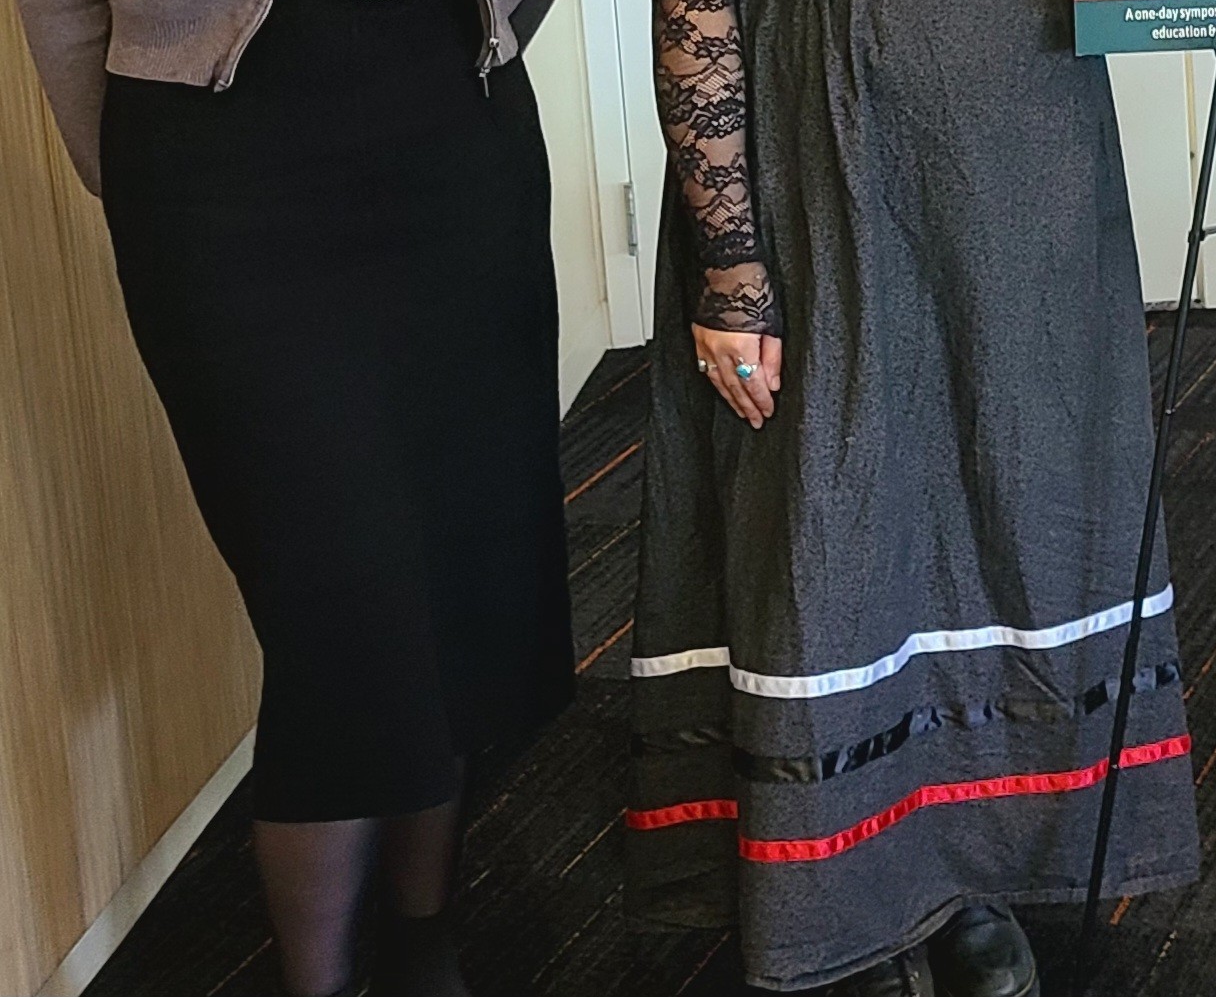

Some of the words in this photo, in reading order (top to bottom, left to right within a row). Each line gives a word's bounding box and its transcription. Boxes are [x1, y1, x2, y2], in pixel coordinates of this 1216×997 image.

[1125, 8, 1134, 21] A
[1135, 5, 1179, 22] one-day
[1152, 24, 1207, 39] education
[1208, 24, 1216, 37] &
